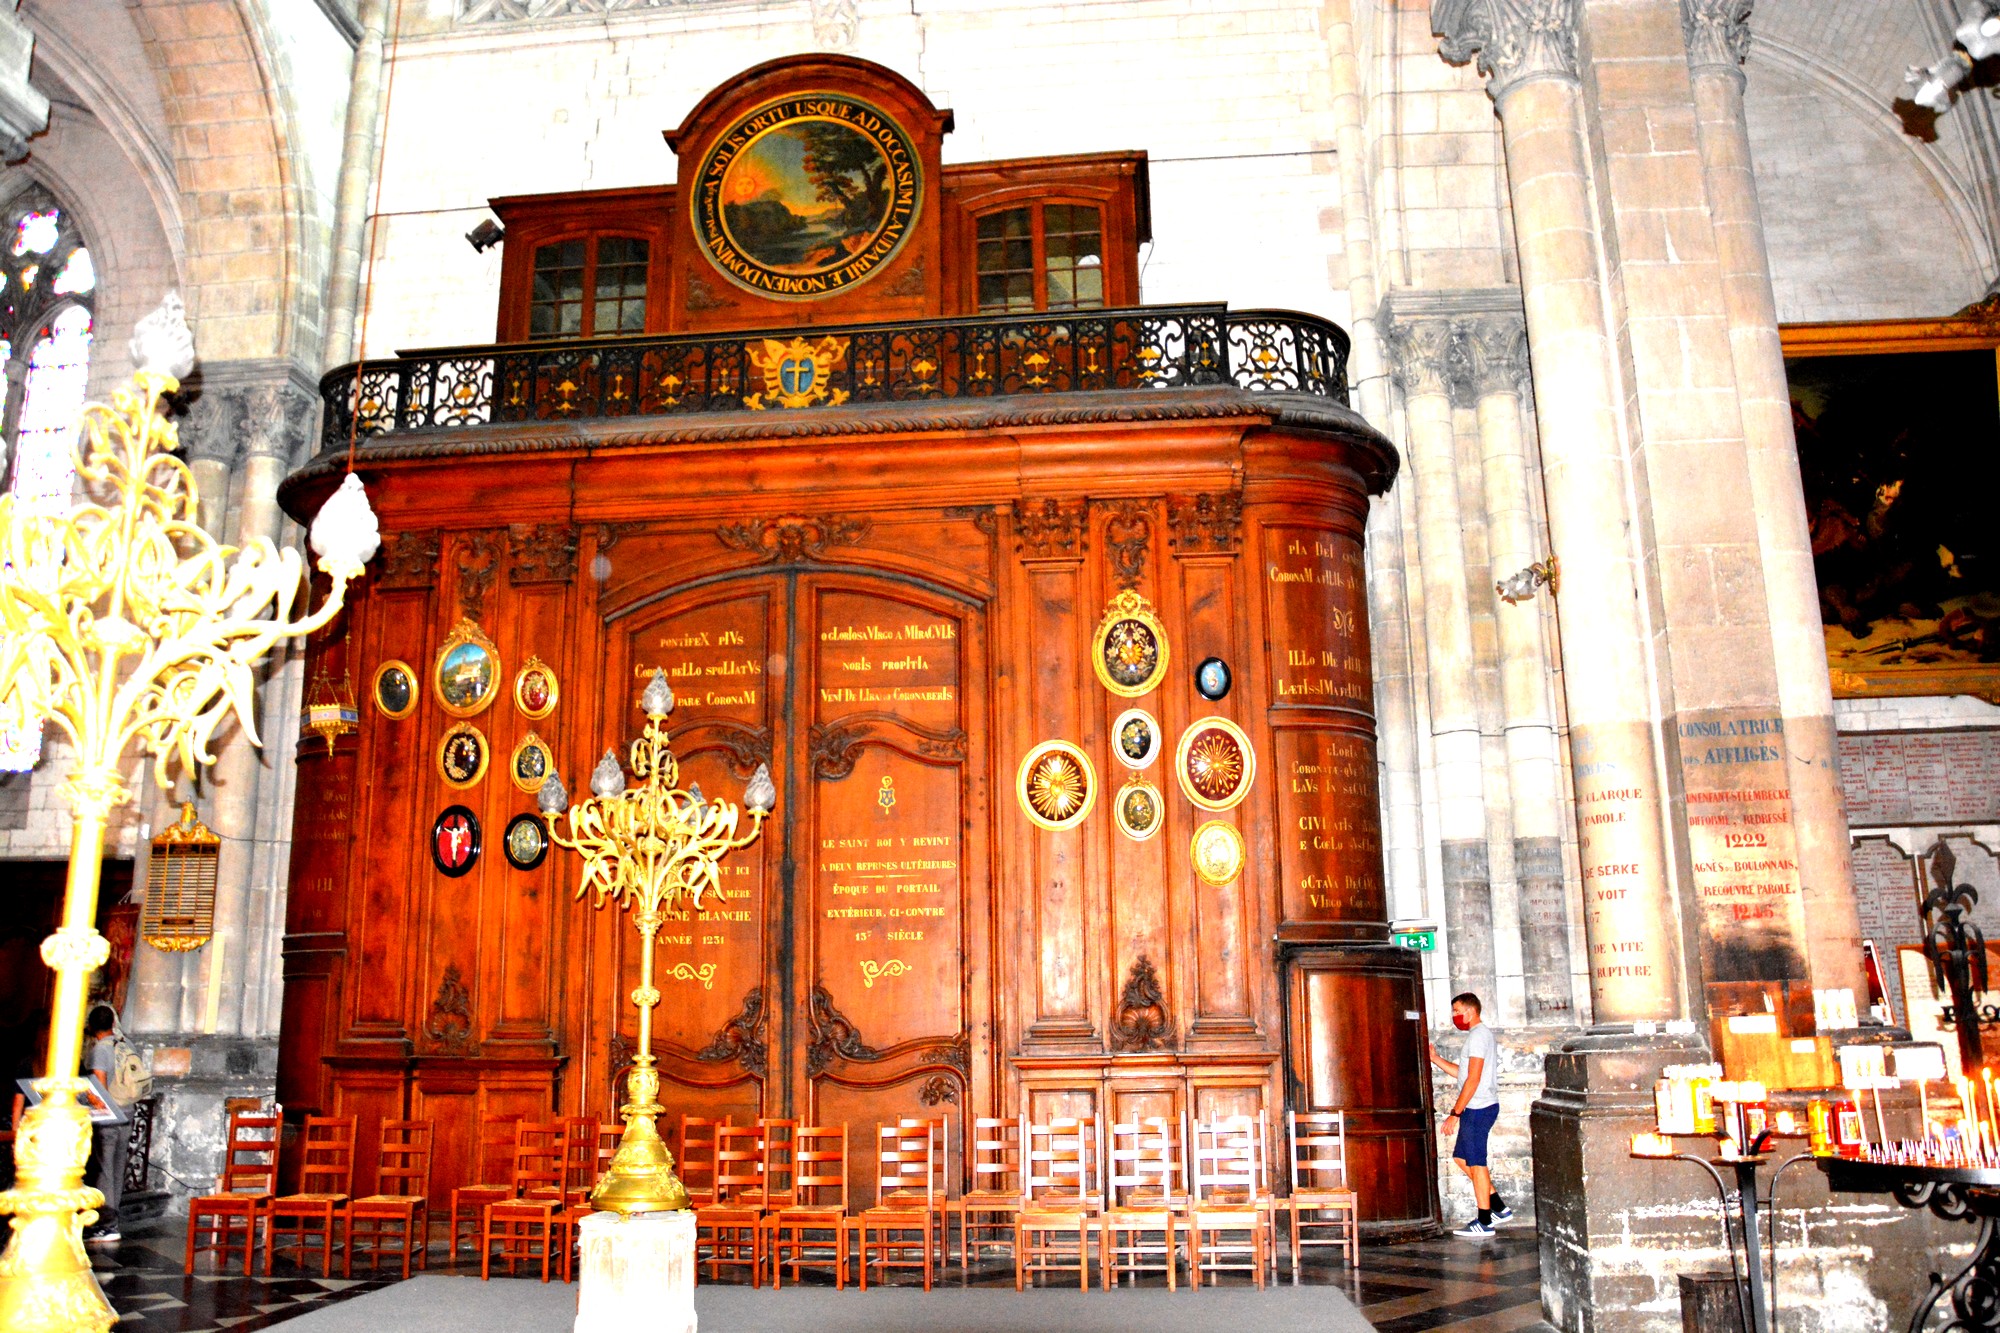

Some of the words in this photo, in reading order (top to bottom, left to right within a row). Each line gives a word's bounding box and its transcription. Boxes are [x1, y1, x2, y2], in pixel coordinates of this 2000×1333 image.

[795, 101, 852, 119] USQUE
[744, 105, 791, 136] ORTU
[852, 111, 881, 131] AD
[709, 133, 746, 177] SOLIS
[878, 130, 914, 205] OCCASUM
[829, 207, 910, 287] LAUDABILE
[707, 234, 759, 285] DOMINI
[761, 270, 827, 292] NOMEN
[634, 663, 668, 677] COROA
[1679, 718, 1783, 737] CONSOLATRICE
[1586, 788, 1642, 803] CLARQUE
[1299, 816, 1353, 831] CIVIATIS
[1584, 812, 1626, 827] PAROLE
[822, 839, 835, 848] LE
[839, 839, 869, 848] SAINT
[876, 838, 892, 847] ROI
[913, 837, 951, 846] REVINT
[1725, 833, 1767, 848] 1222
[736, 866, 750, 875] ICI
[820, 863, 827, 871] A
[829, 863, 852, 871] DEUX
[856, 862, 898, 871] REPRISES
[900, 859, 956, 870] ULTÉRIEURES
[1597, 864, 1639, 877] SERKE
[833, 883, 869, 896] ÉPOQUE
[875, 885, 888, 893] DU
[896, 884, 940, 893] PORTAIL
[1597, 888, 1627, 901] VOIT
[1703, 885, 1755, 897] RECOUVRE
[1757, 883, 1796, 895] PAROLE.
[698, 911, 751, 922] BLANCHE
[889, 907, 945, 917] CI-CONTRE
[887, 929, 924, 940] SIÈCLE
[1594, 943, 1607, 954] DE
[1612, 941, 1644, 953] VITE
[1597, 965, 1652, 978] RUPTURE
